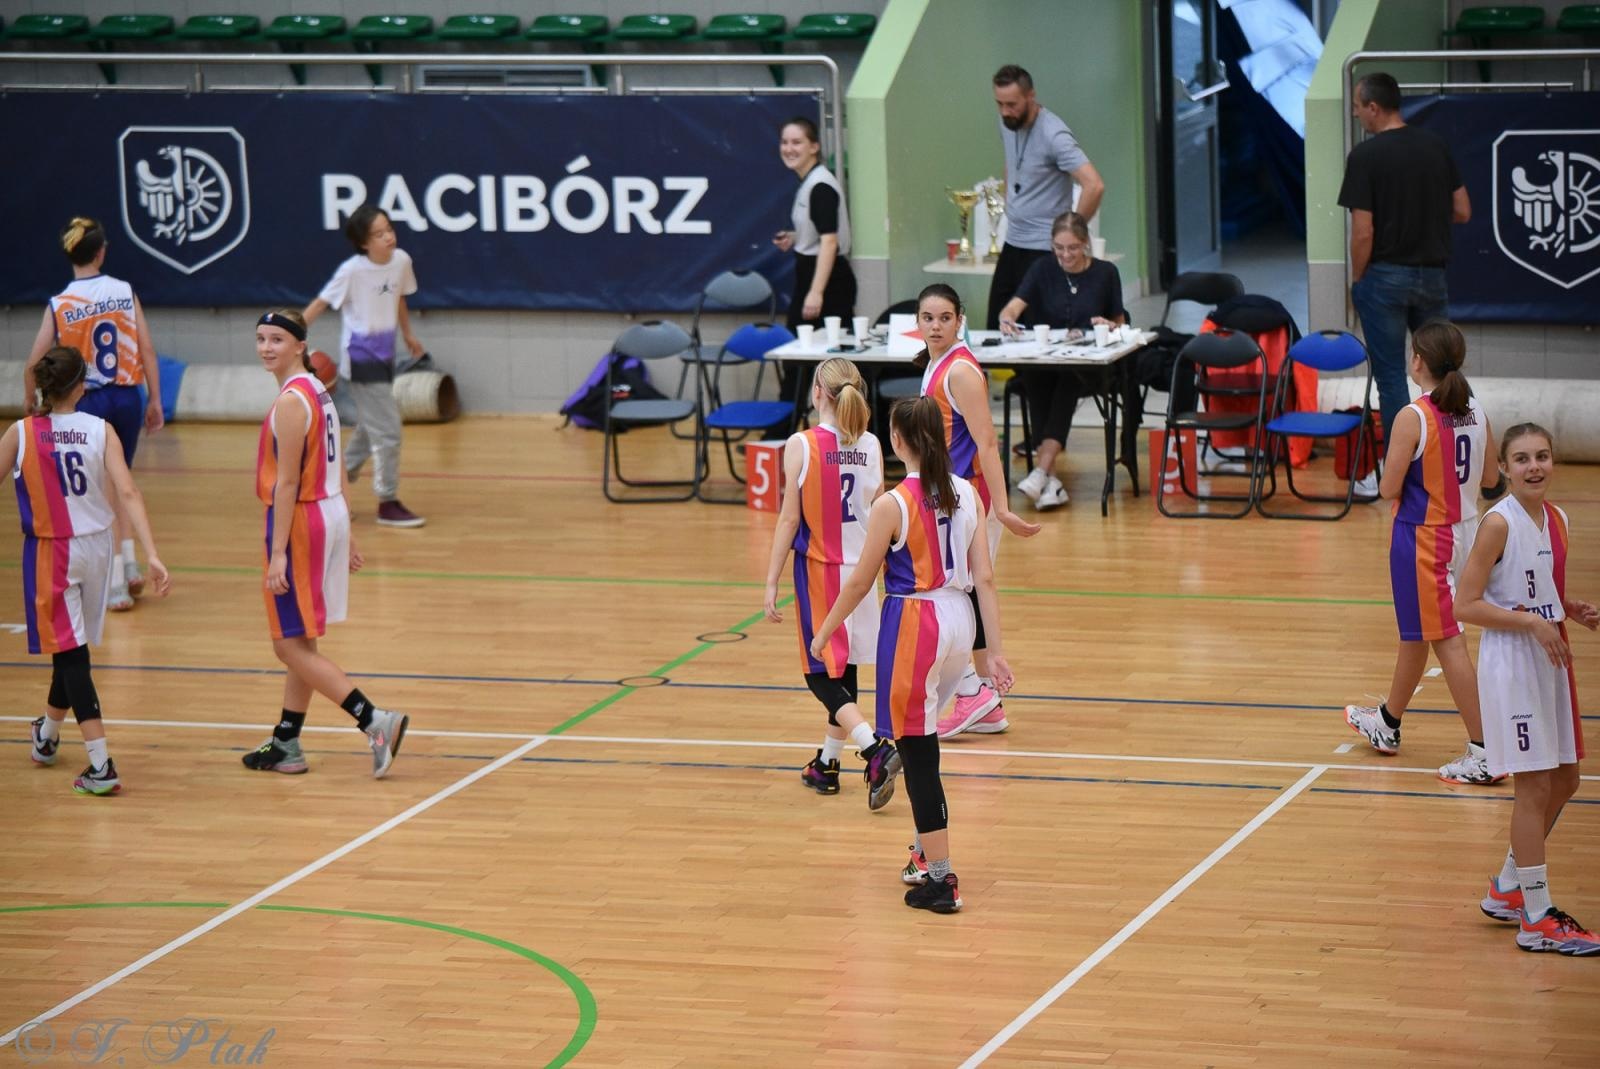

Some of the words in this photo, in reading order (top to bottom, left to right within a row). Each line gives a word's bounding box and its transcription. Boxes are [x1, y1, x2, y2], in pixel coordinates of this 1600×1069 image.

[321, 154, 713, 235] RACIBÓRZ
[64, 296, 134, 324] RACIBÓRZ
[93, 321, 118, 379] 8
[40, 427, 89, 446] RACIBÓRZ
[326, 412, 336, 463] 6
[825, 447, 868, 467] RACIBÓRZ
[1455, 433, 1472, 486] 9
[49, 450, 88, 497] 16
[751, 451, 771, 496] 5
[840, 472, 858, 523] 2
[937, 516, 954, 571] 7
[1524, 568, 1536, 600] 5
[1516, 721, 1530, 752] 5
